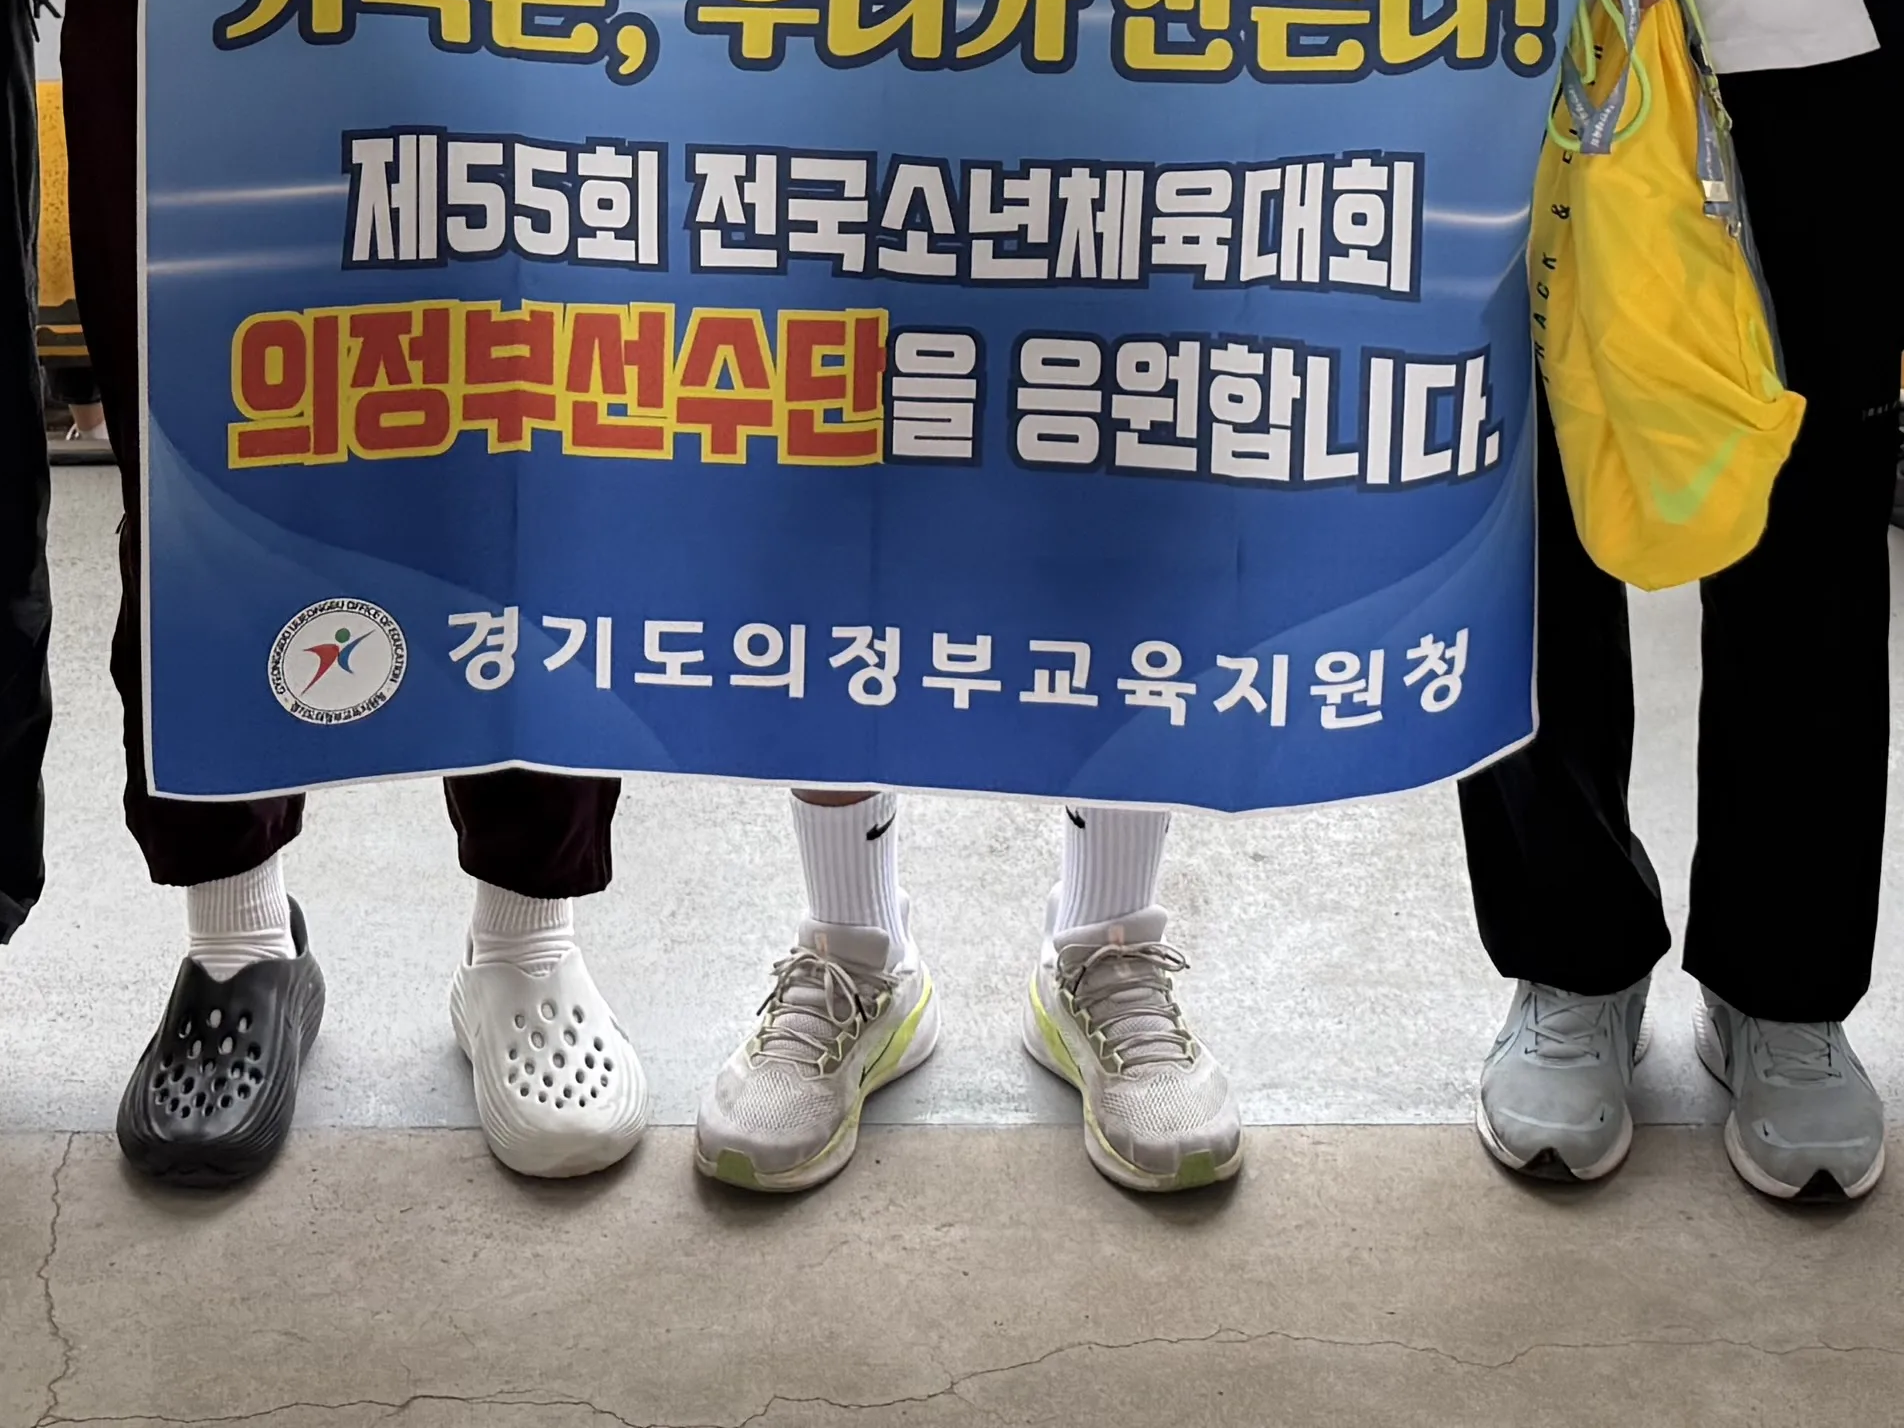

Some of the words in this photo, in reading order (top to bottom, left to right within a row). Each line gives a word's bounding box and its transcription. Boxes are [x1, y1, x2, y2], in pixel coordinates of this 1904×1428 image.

[348, 134, 662, 267] 제55회
[692, 148, 1418, 296] 전국소년체육대회
[229, 302, 979, 468] 의정부선수단을
[1017, 336, 1500, 485] 응원합니다.
[446, 604, 1472, 730] 경기도의정부교육지원청
